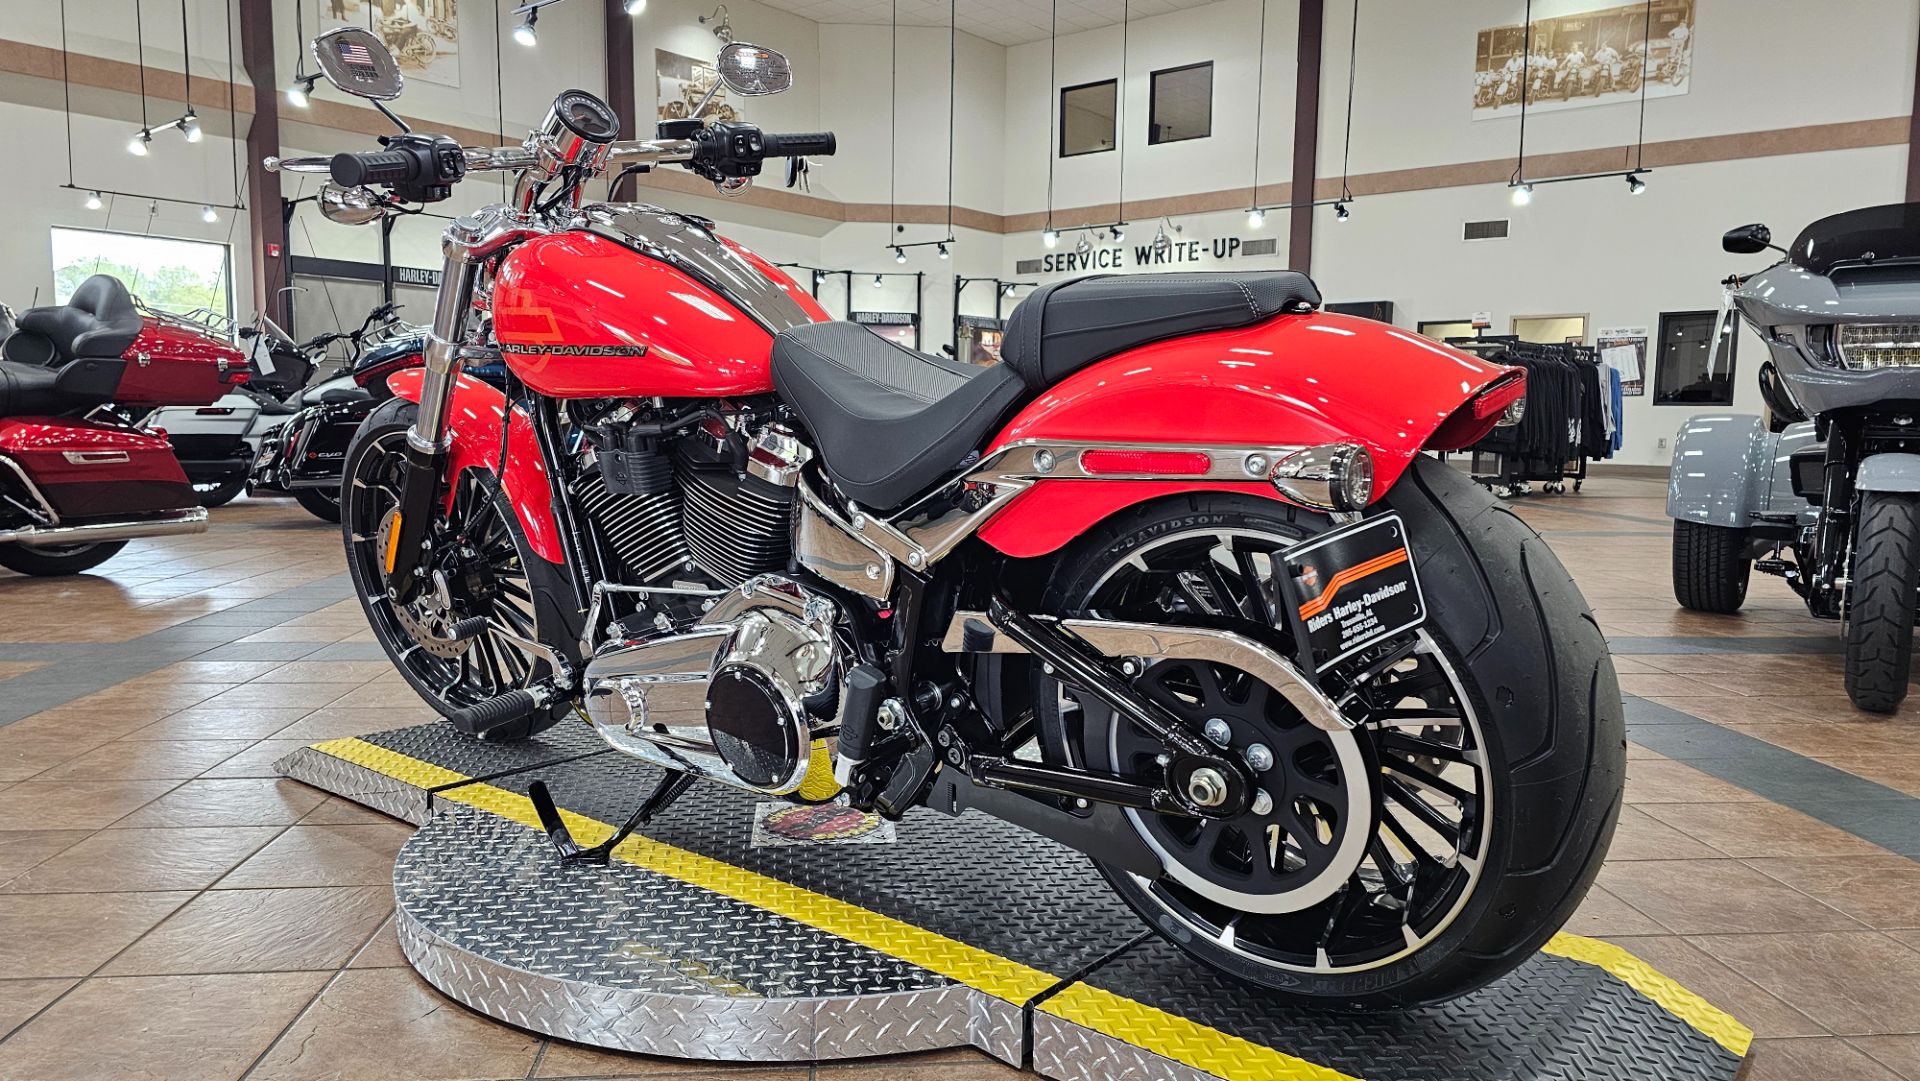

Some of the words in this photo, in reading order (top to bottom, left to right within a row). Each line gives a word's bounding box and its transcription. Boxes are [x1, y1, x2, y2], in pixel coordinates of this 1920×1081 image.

[1043, 248, 1123, 273] SERVICE
[1134, 237, 1241, 266] WRITE-UP
[856, 312, 912, 324] HARLEY-DAVIDSON
[1307, 612, 1334, 634] Riders
[1332, 582, 1407, 620] Harley-Davidson
